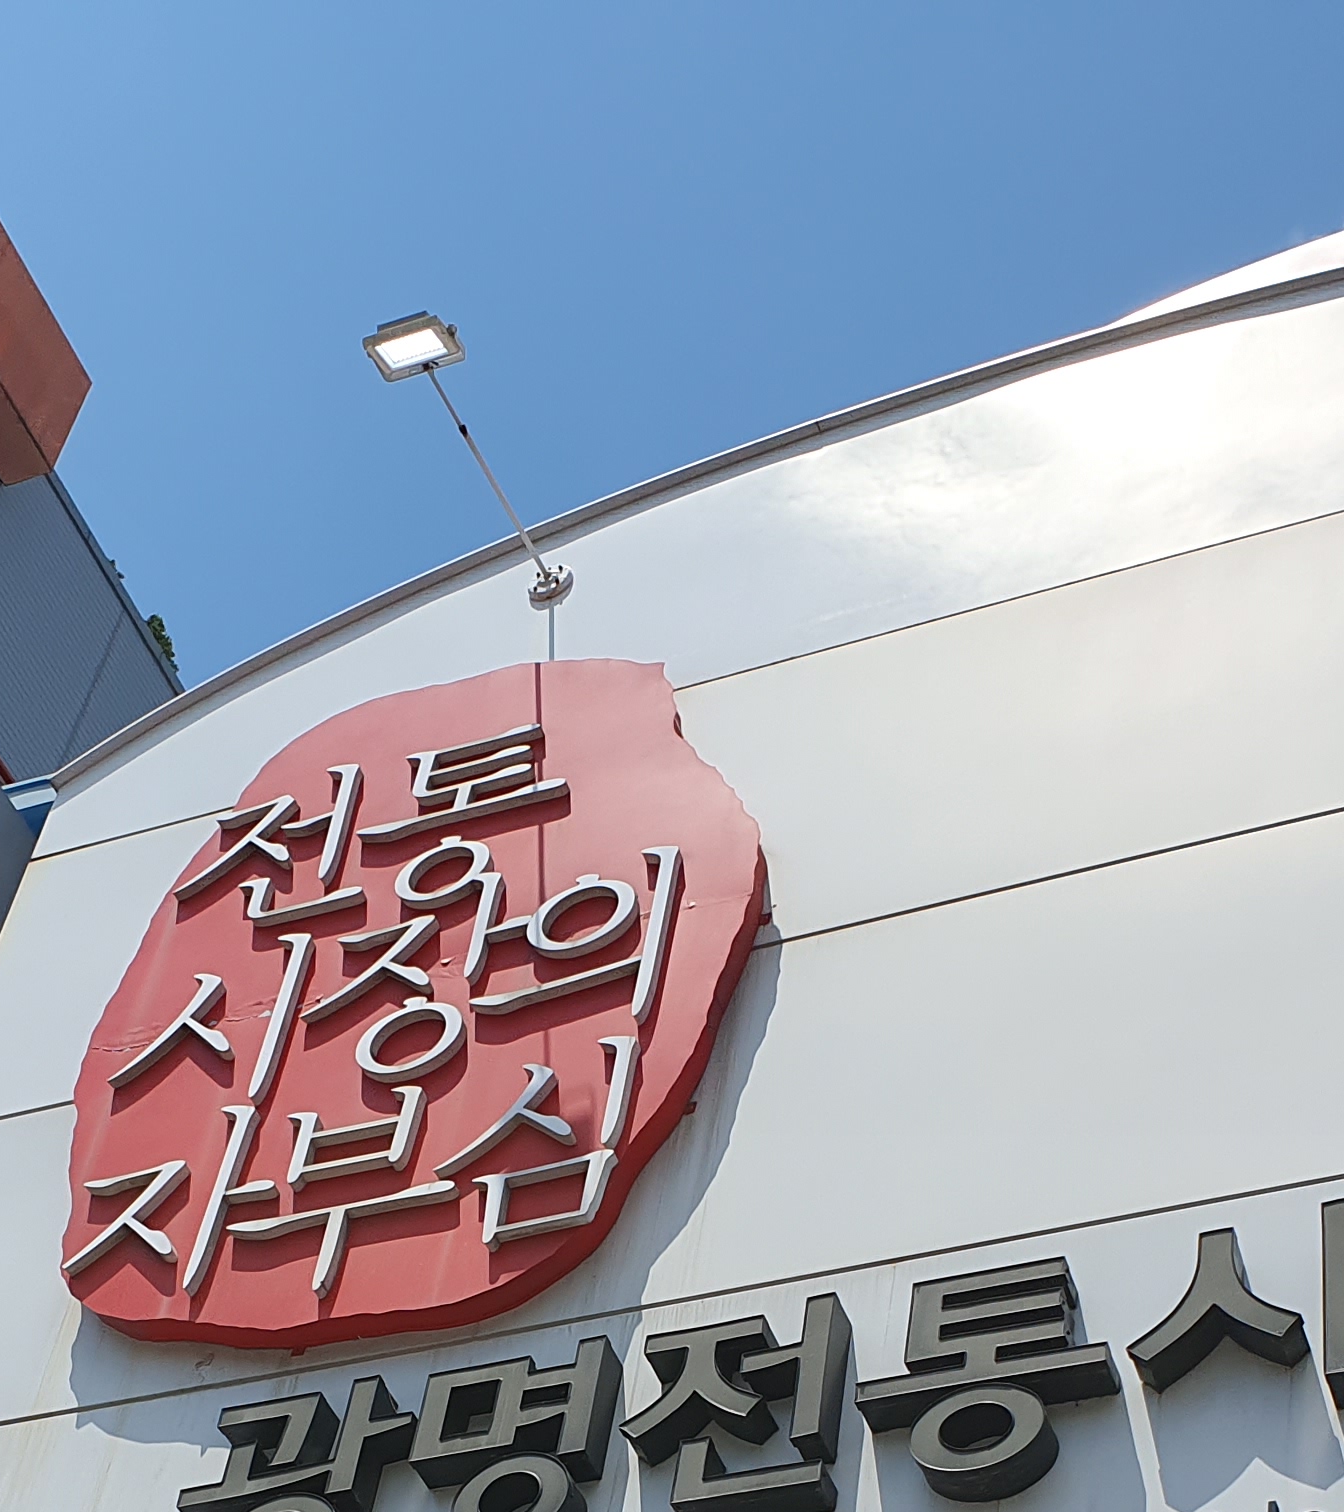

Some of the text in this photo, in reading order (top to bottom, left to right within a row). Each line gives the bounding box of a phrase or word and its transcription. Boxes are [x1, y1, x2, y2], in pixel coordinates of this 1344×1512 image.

[174, 722, 571, 927] 전통
[107, 846, 680, 1100] 시장의
[61, 1036, 640, 1300] 자부심
